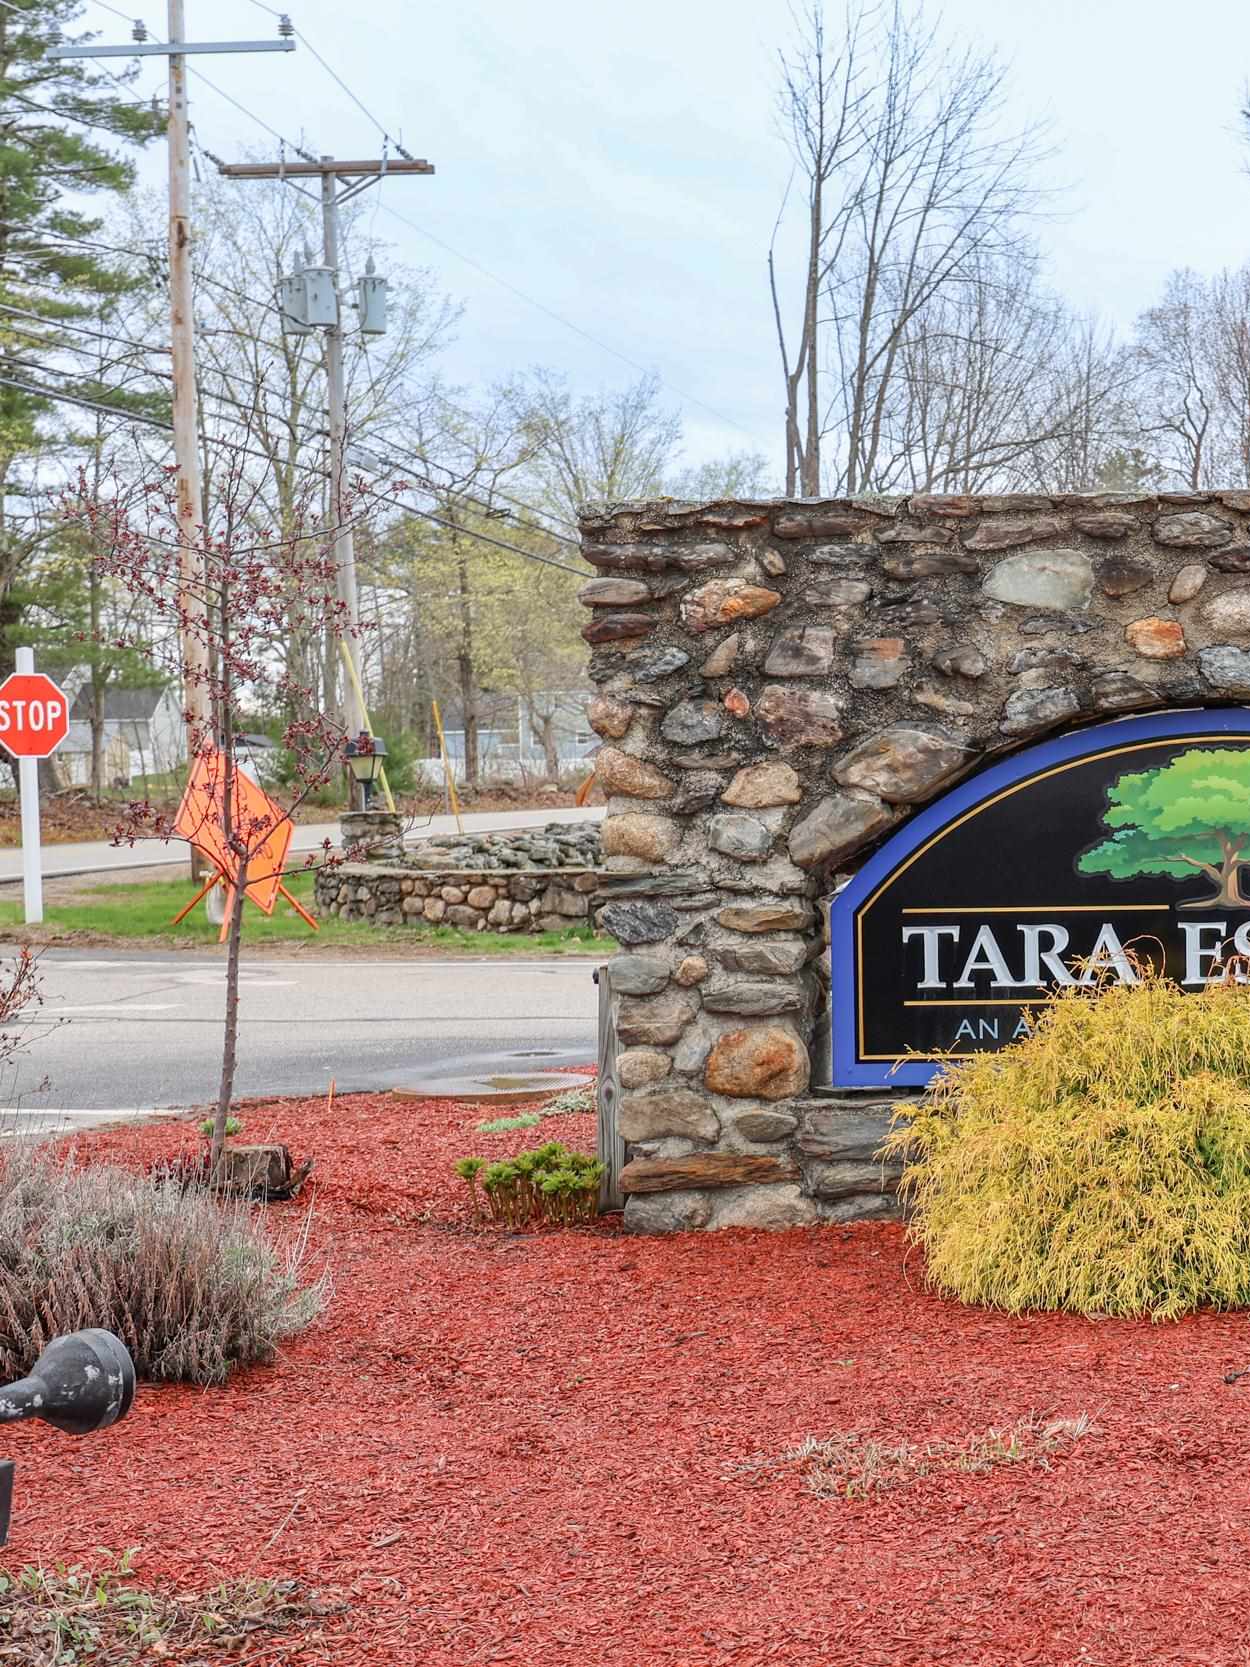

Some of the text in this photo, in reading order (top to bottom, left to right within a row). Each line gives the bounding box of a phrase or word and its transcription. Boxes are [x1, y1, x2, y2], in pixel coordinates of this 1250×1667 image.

[0, 700, 62, 732] STOP
[902, 922, 1147, 989] TARA
[954, 1018, 999, 1040] AN
